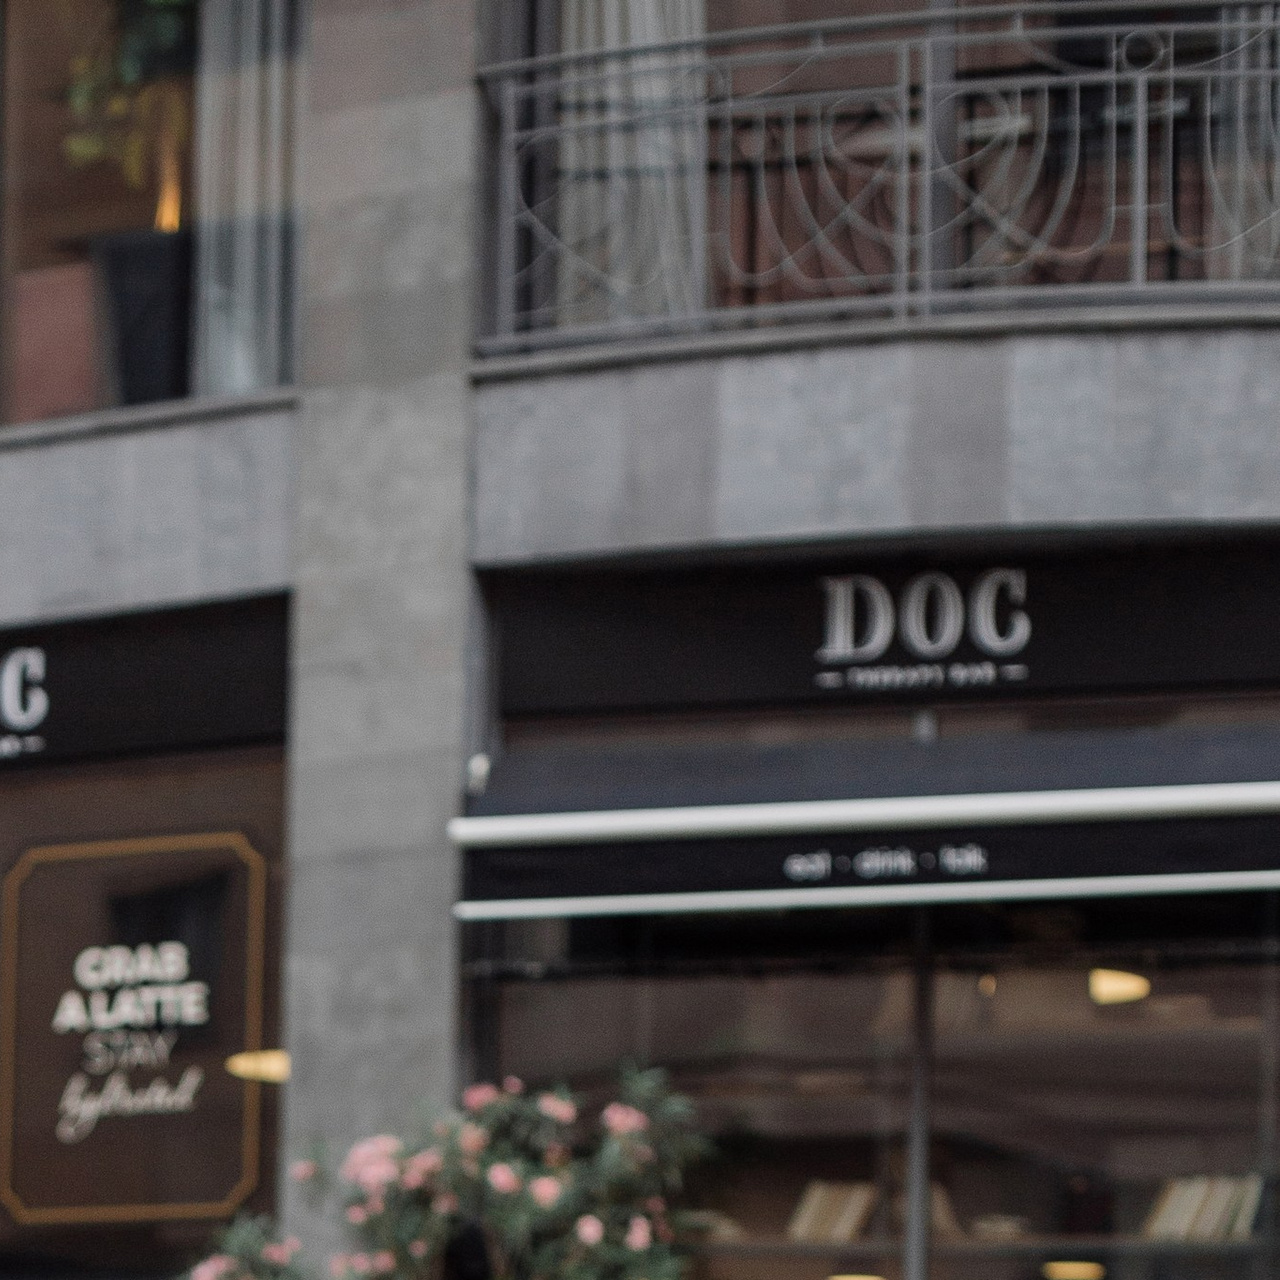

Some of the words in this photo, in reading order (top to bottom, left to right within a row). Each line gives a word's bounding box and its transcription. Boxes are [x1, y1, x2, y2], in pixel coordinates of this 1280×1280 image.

[816, 568, 1031, 663] DOC
[74, 942, 189, 989] GRAB
[52, 990, 87, 1033] A
[88, 981, 209, 1031] LATTE
